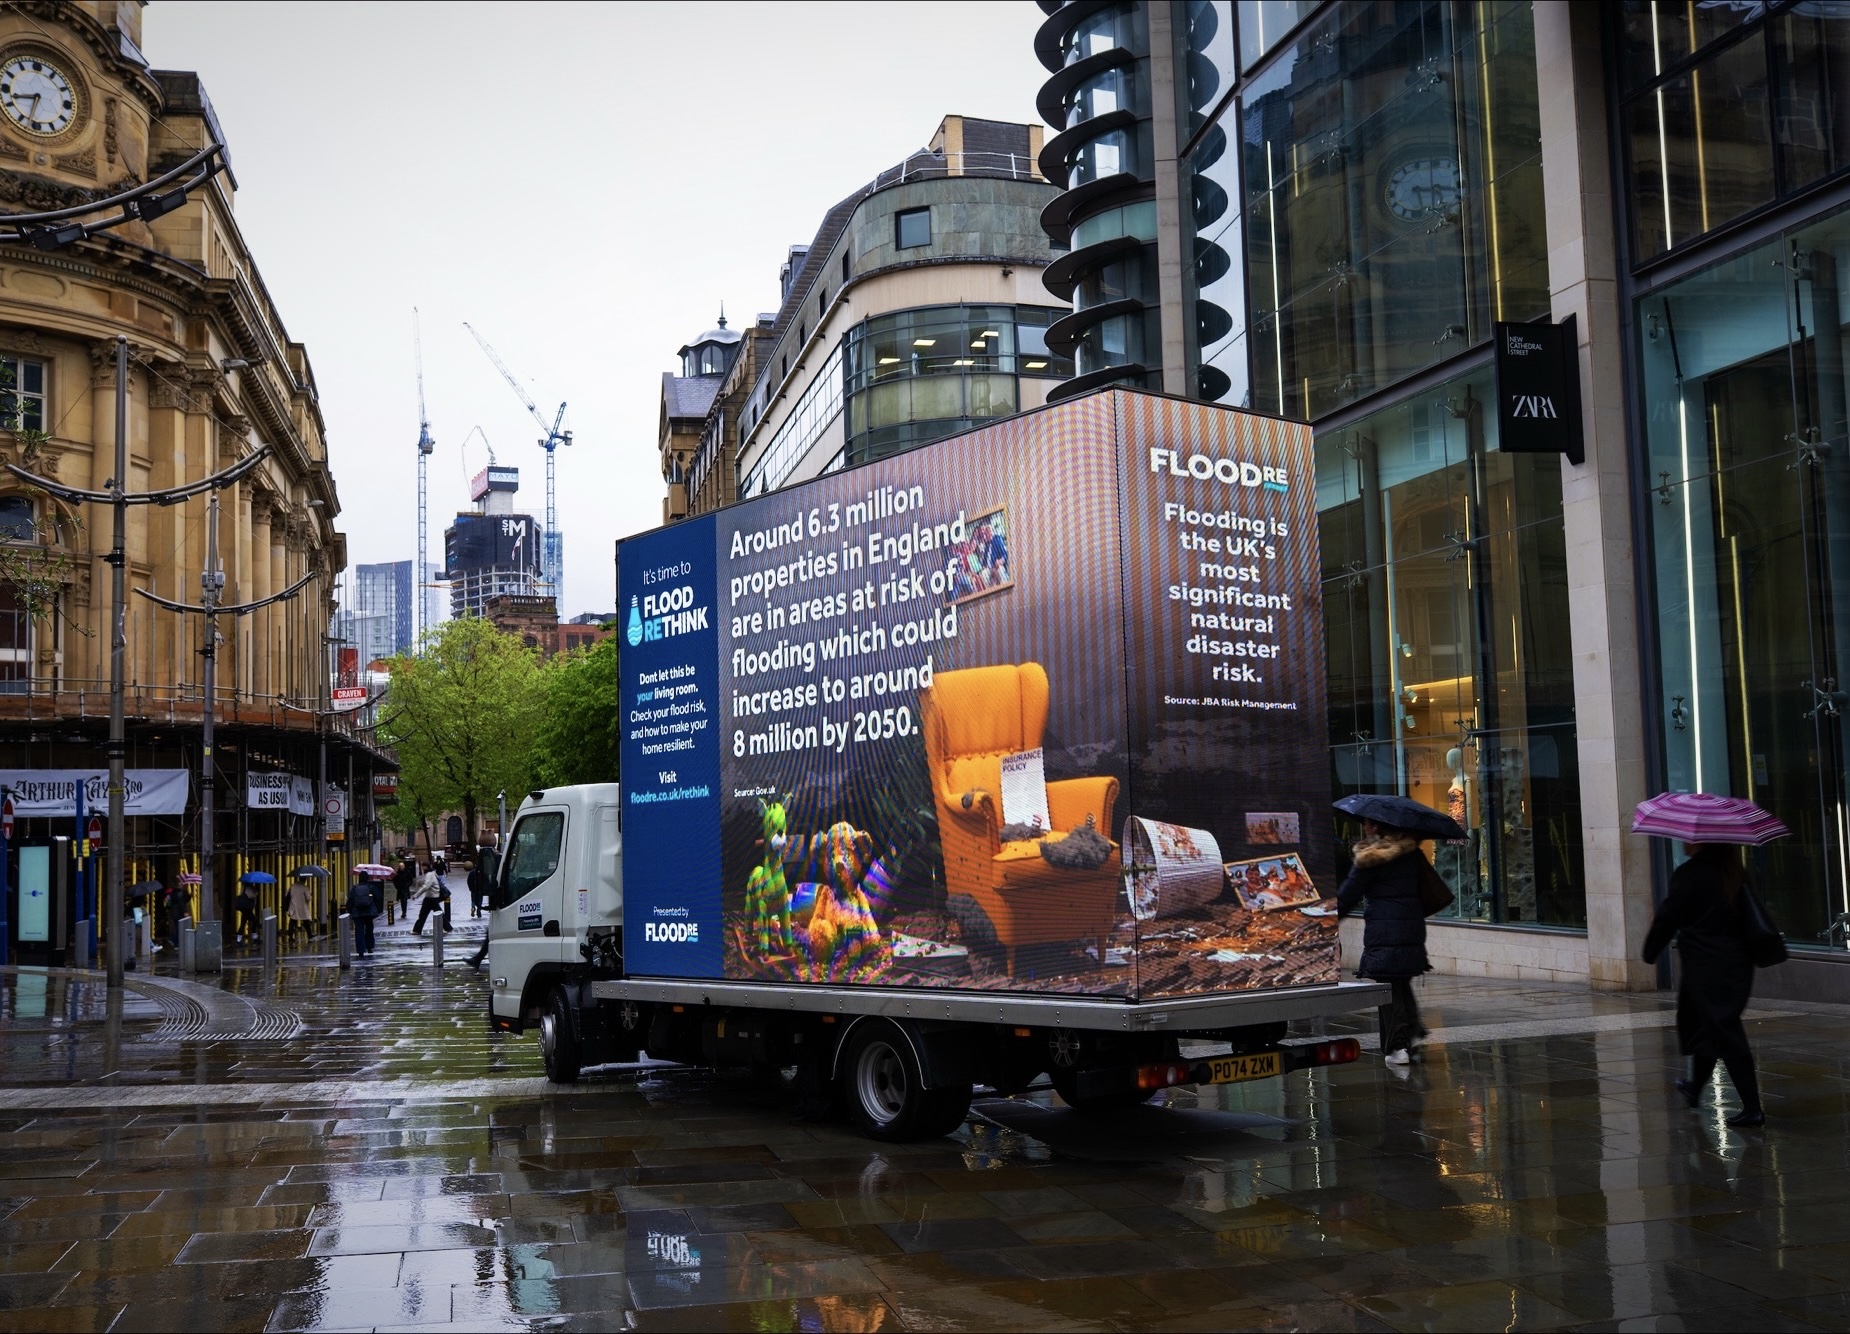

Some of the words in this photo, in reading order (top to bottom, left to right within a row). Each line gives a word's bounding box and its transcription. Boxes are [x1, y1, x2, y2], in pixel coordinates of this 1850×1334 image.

[1510, 342, 1542, 350] CATHEDRAL
[1512, 395, 1558, 418] ZARA
[730, 512, 803, 559] Around
[808, 502, 840, 537] 6.3
[845, 485, 923, 527] million
[1164, 502, 1265, 538] Flooding
[1270, 517, 1288, 537] is
[1179, 531, 1221, 554] the
[1226, 536, 1276, 560] UK's
[730, 549, 838, 606] properties
[842, 541, 863, 571] in
[868, 510, 966, 566] England
[643, 569, 656, 586] It's
[658, 565, 678, 582] time
[680, 560, 691, 575] to
[1199, 561, 1261, 583] most
[644, 585, 694, 618] FLOOD
[731, 614, 763, 638] are
[767, 602, 785, 630] in
[789, 591, 847, 627] areas
[852, 581, 876, 613] at
[881, 567, 925, 606] risk
[930, 557, 958, 595] of
[1168, 581, 1292, 611] significant
[644, 606, 709, 643] RETHINK
[1190, 611, 1274, 634] natural
[732, 639, 815, 677] flooding
[820, 621, 886, 661] which
[891, 605, 958, 648] could
[1186, 634, 1280, 659] disaster
[639, 671, 658, 686] Dont
[658, 670, 669, 682] let
[670, 665, 685, 680] this
[686, 664, 696, 676] be
[1212, 662, 1263, 684] risk.
[338, 690, 362, 698] CRAVEN
[637, 691, 654, 706] your
[654, 686, 674, 700] living
[676, 684, 698, 696] room.
[733, 683, 817, 717] increase
[822, 675, 845, 704] to
[850, 655, 934, 700] around
[630, 706, 652, 724] Check
[652, 708, 669, 722] your
[670, 702, 689, 716] flood
[1164, 696, 1200, 706] Source:
[1201, 698, 1220, 707] JBA
[1221, 698, 1240, 708] Risk
[1242, 699, 1297, 711] Management
[630, 726, 644, 740] and
[644, 725, 660, 739] how
[660, 724, 669, 736] to
[670, 720, 690, 734] make
[690, 718, 708, 734] your
[733, 730, 746, 758] 8
[750, 722, 818, 756] million
[822, 716, 849, 753] by
[854, 705, 918, 743] 2050.
[642, 741, 663, 756] home
[663, 737, 696, 752] resilient.
[1002, 750, 1042, 764] INSURANCE
[658, 770, 677, 785] Visit
[1002, 762, 1027, 773] POLICY
[258, 792, 268, 804] AS
[630, 784, 710, 804] floodre.co.uk/rethink
[654, 906, 682, 917] Presented
[682, 907, 690, 918] by
[1250, 1056, 1274, 1075] ZXM
